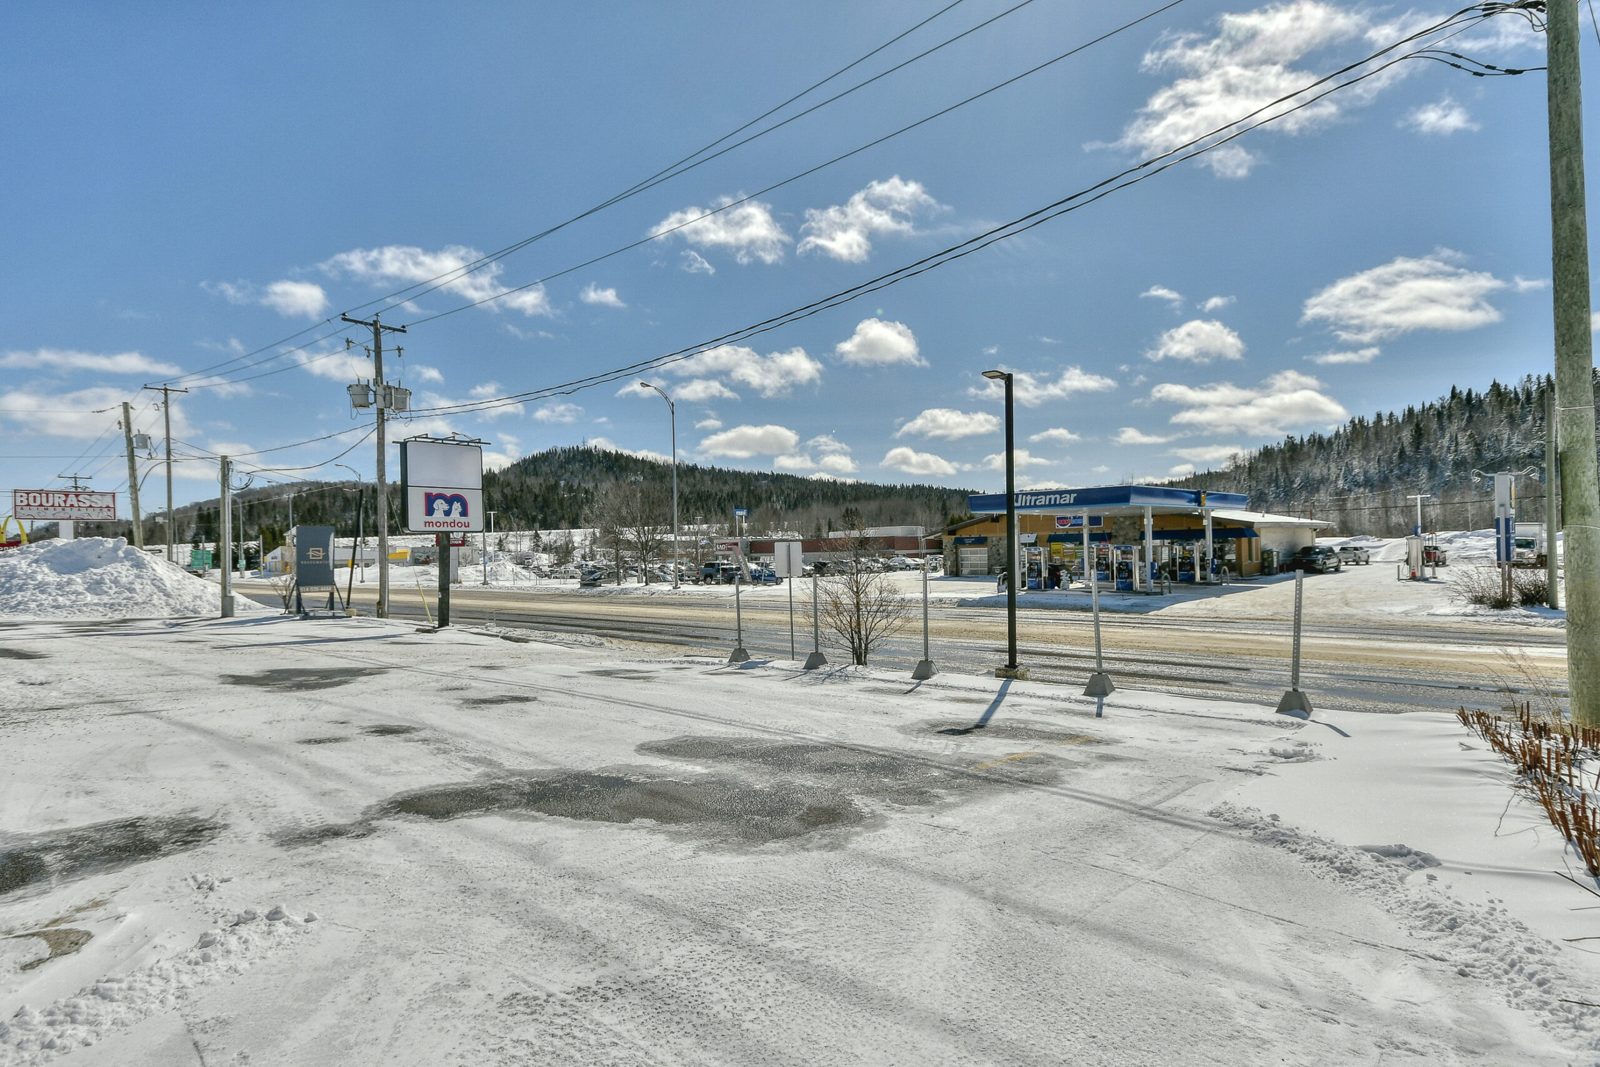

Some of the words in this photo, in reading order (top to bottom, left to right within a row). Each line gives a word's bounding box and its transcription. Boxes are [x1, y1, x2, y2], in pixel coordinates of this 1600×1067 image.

[16, 492, 114, 507] BOURASSA
[1014, 493, 1077, 507] Ultramar
[424, 519, 470, 528] mondou
